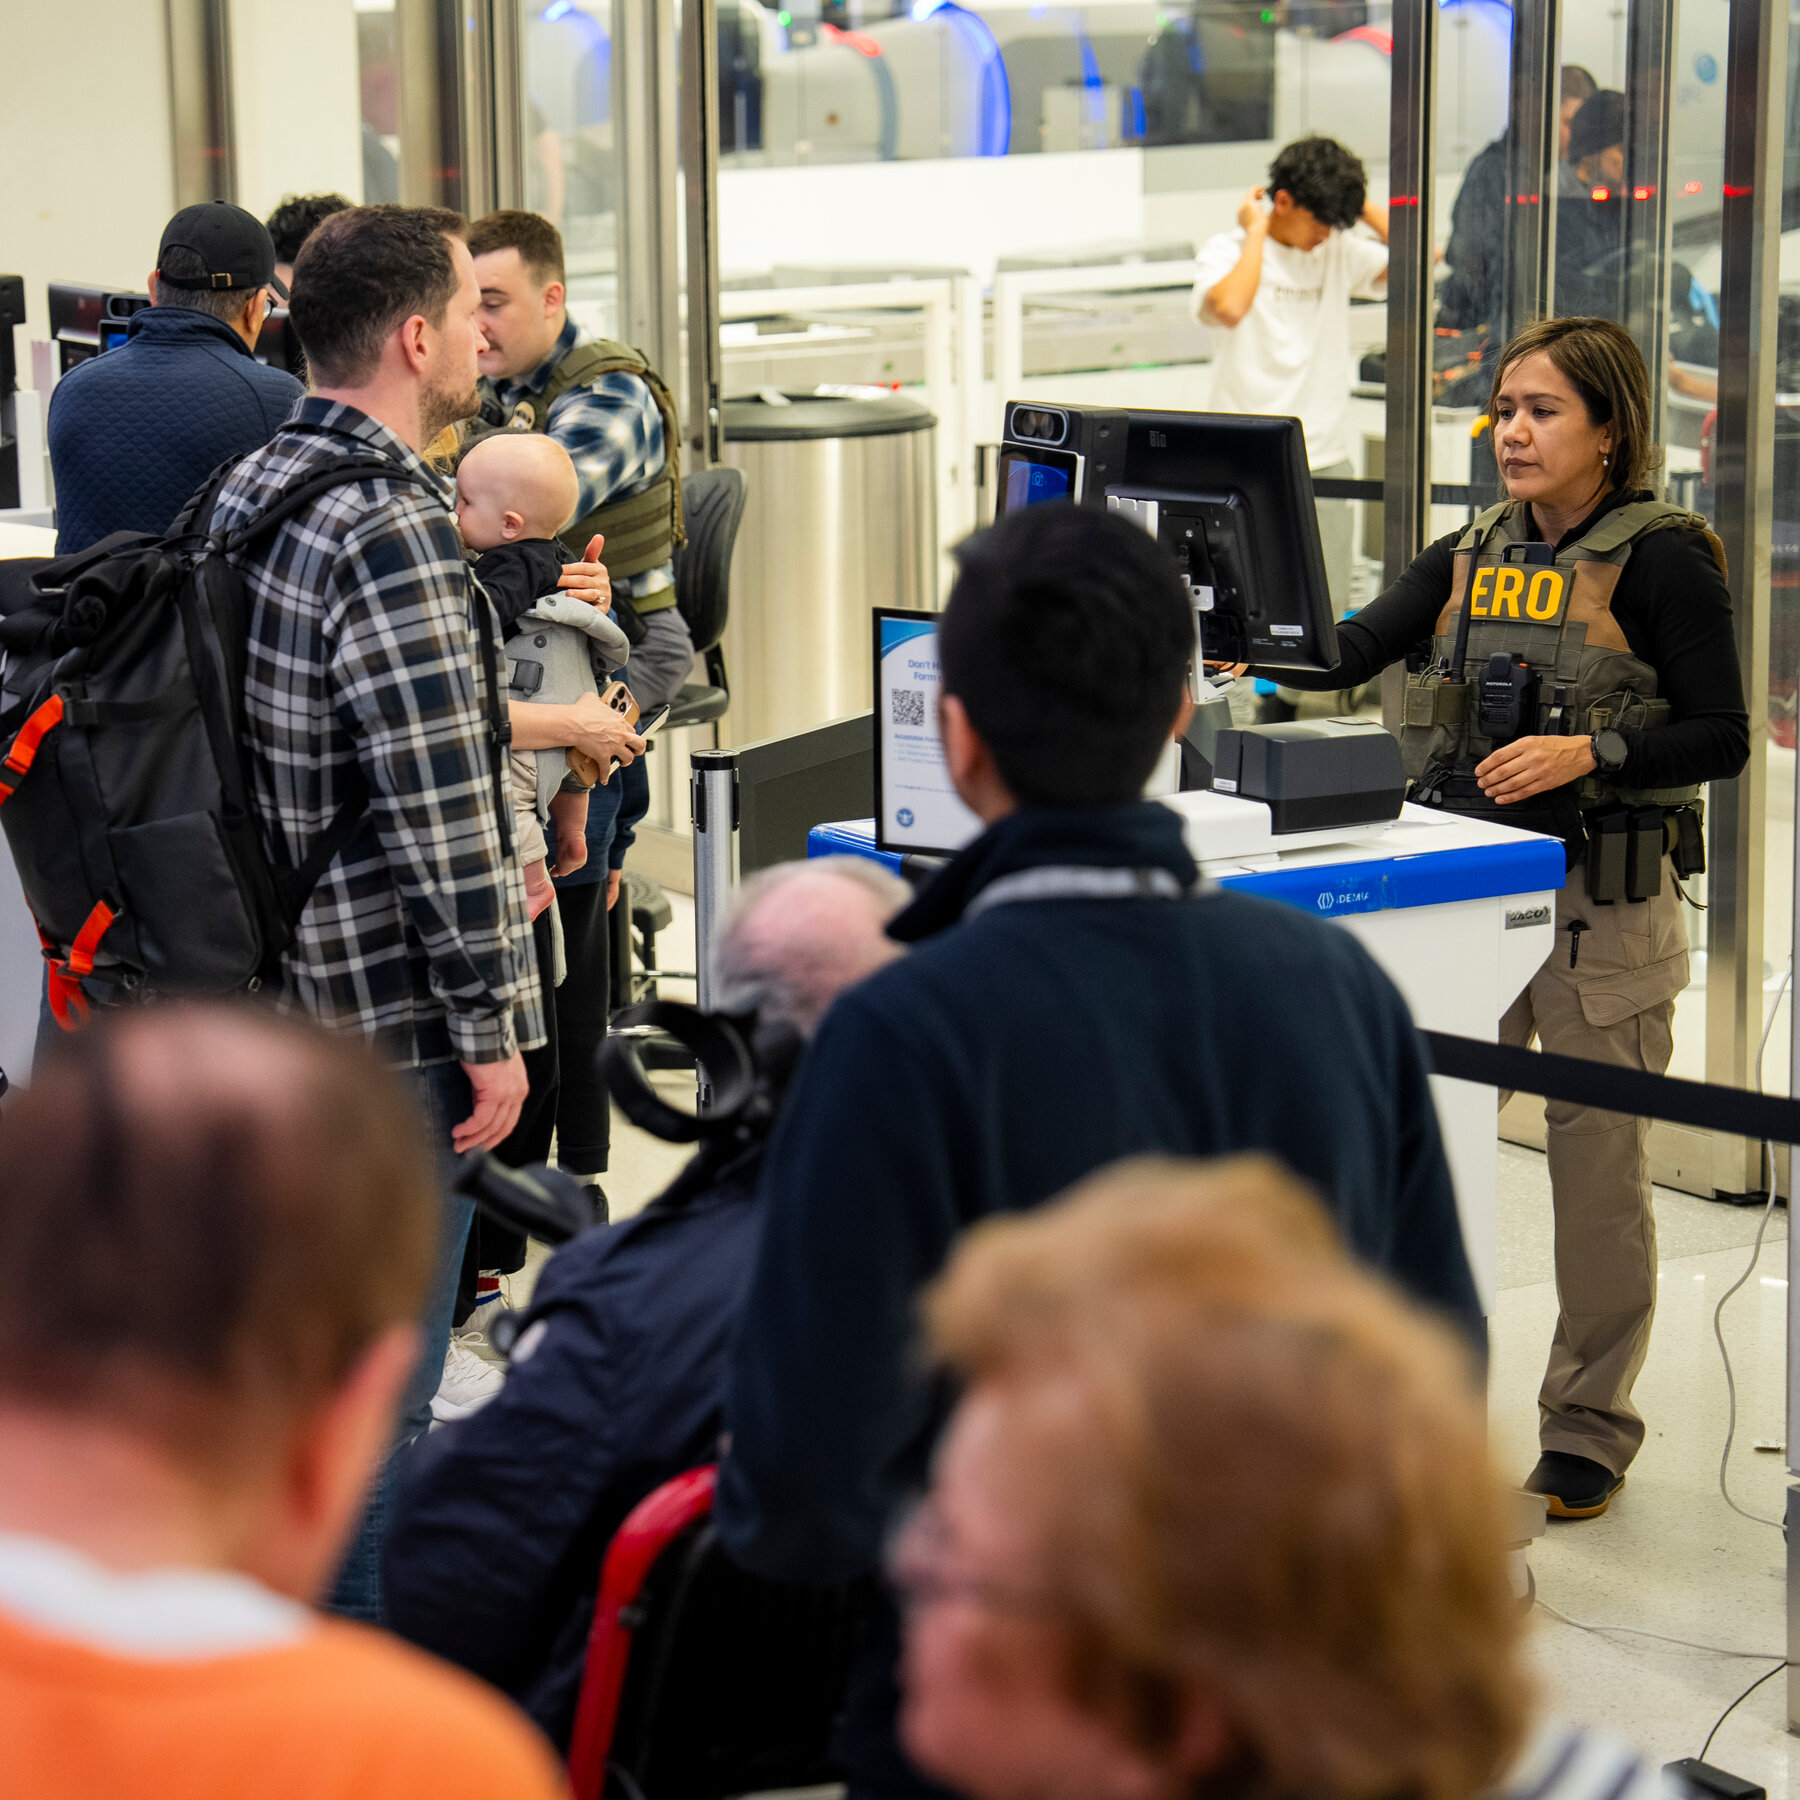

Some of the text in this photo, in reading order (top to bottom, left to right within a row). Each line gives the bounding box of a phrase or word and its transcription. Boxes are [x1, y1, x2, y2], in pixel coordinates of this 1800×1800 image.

[1471, 567, 1564, 620] ERO
[908, 659, 931, 669] Don't
[913, 672, 936, 681] Form
